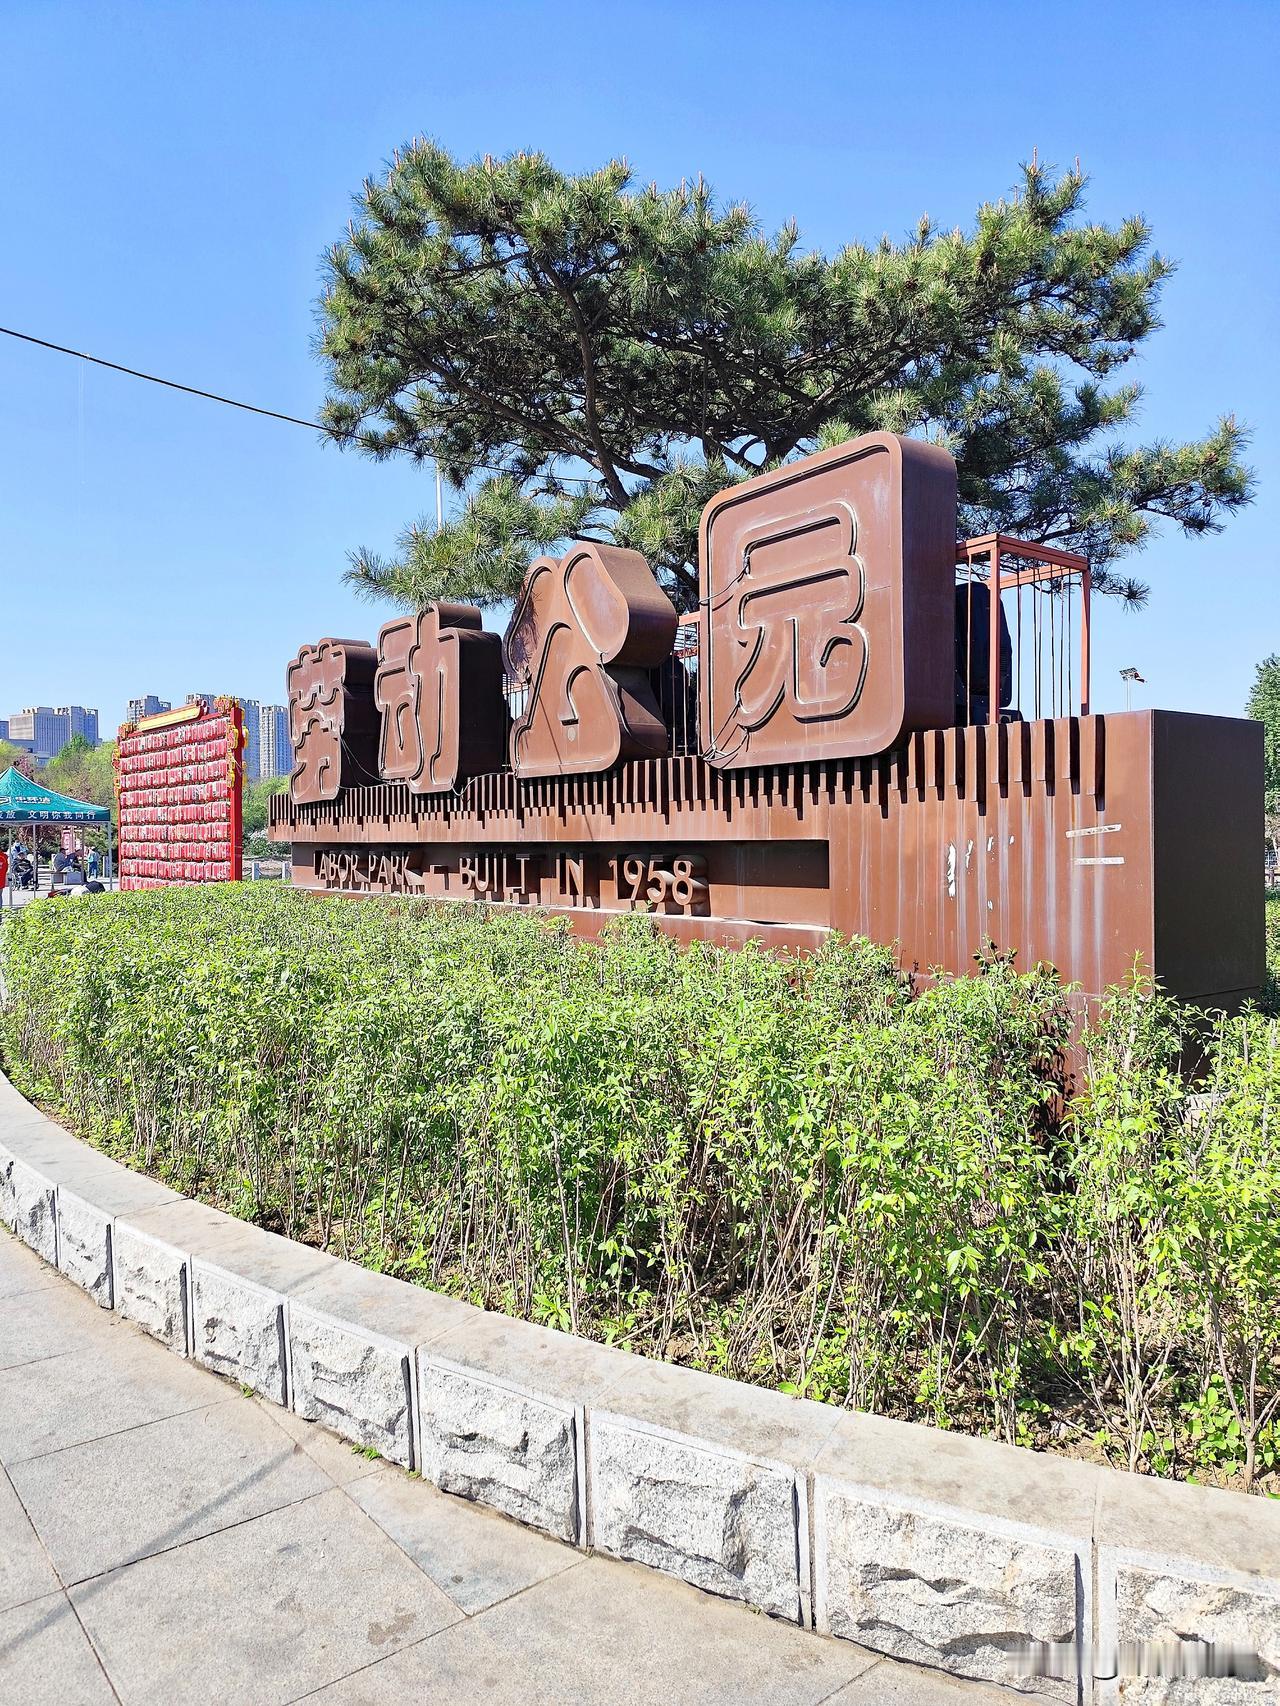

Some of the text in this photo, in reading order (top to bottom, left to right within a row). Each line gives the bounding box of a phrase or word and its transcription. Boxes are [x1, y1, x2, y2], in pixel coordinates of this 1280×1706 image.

[287, 430, 905, 806] 劳动公园
[28, 810, 96, 820] 文明你我同行
[313, 852, 361, 883] LABOR
[368, 853, 411, 886] PARK
[459, 856, 530, 894] BUILT
[556, 857, 584, 897] IN
[608, 857, 694, 906] 1958
